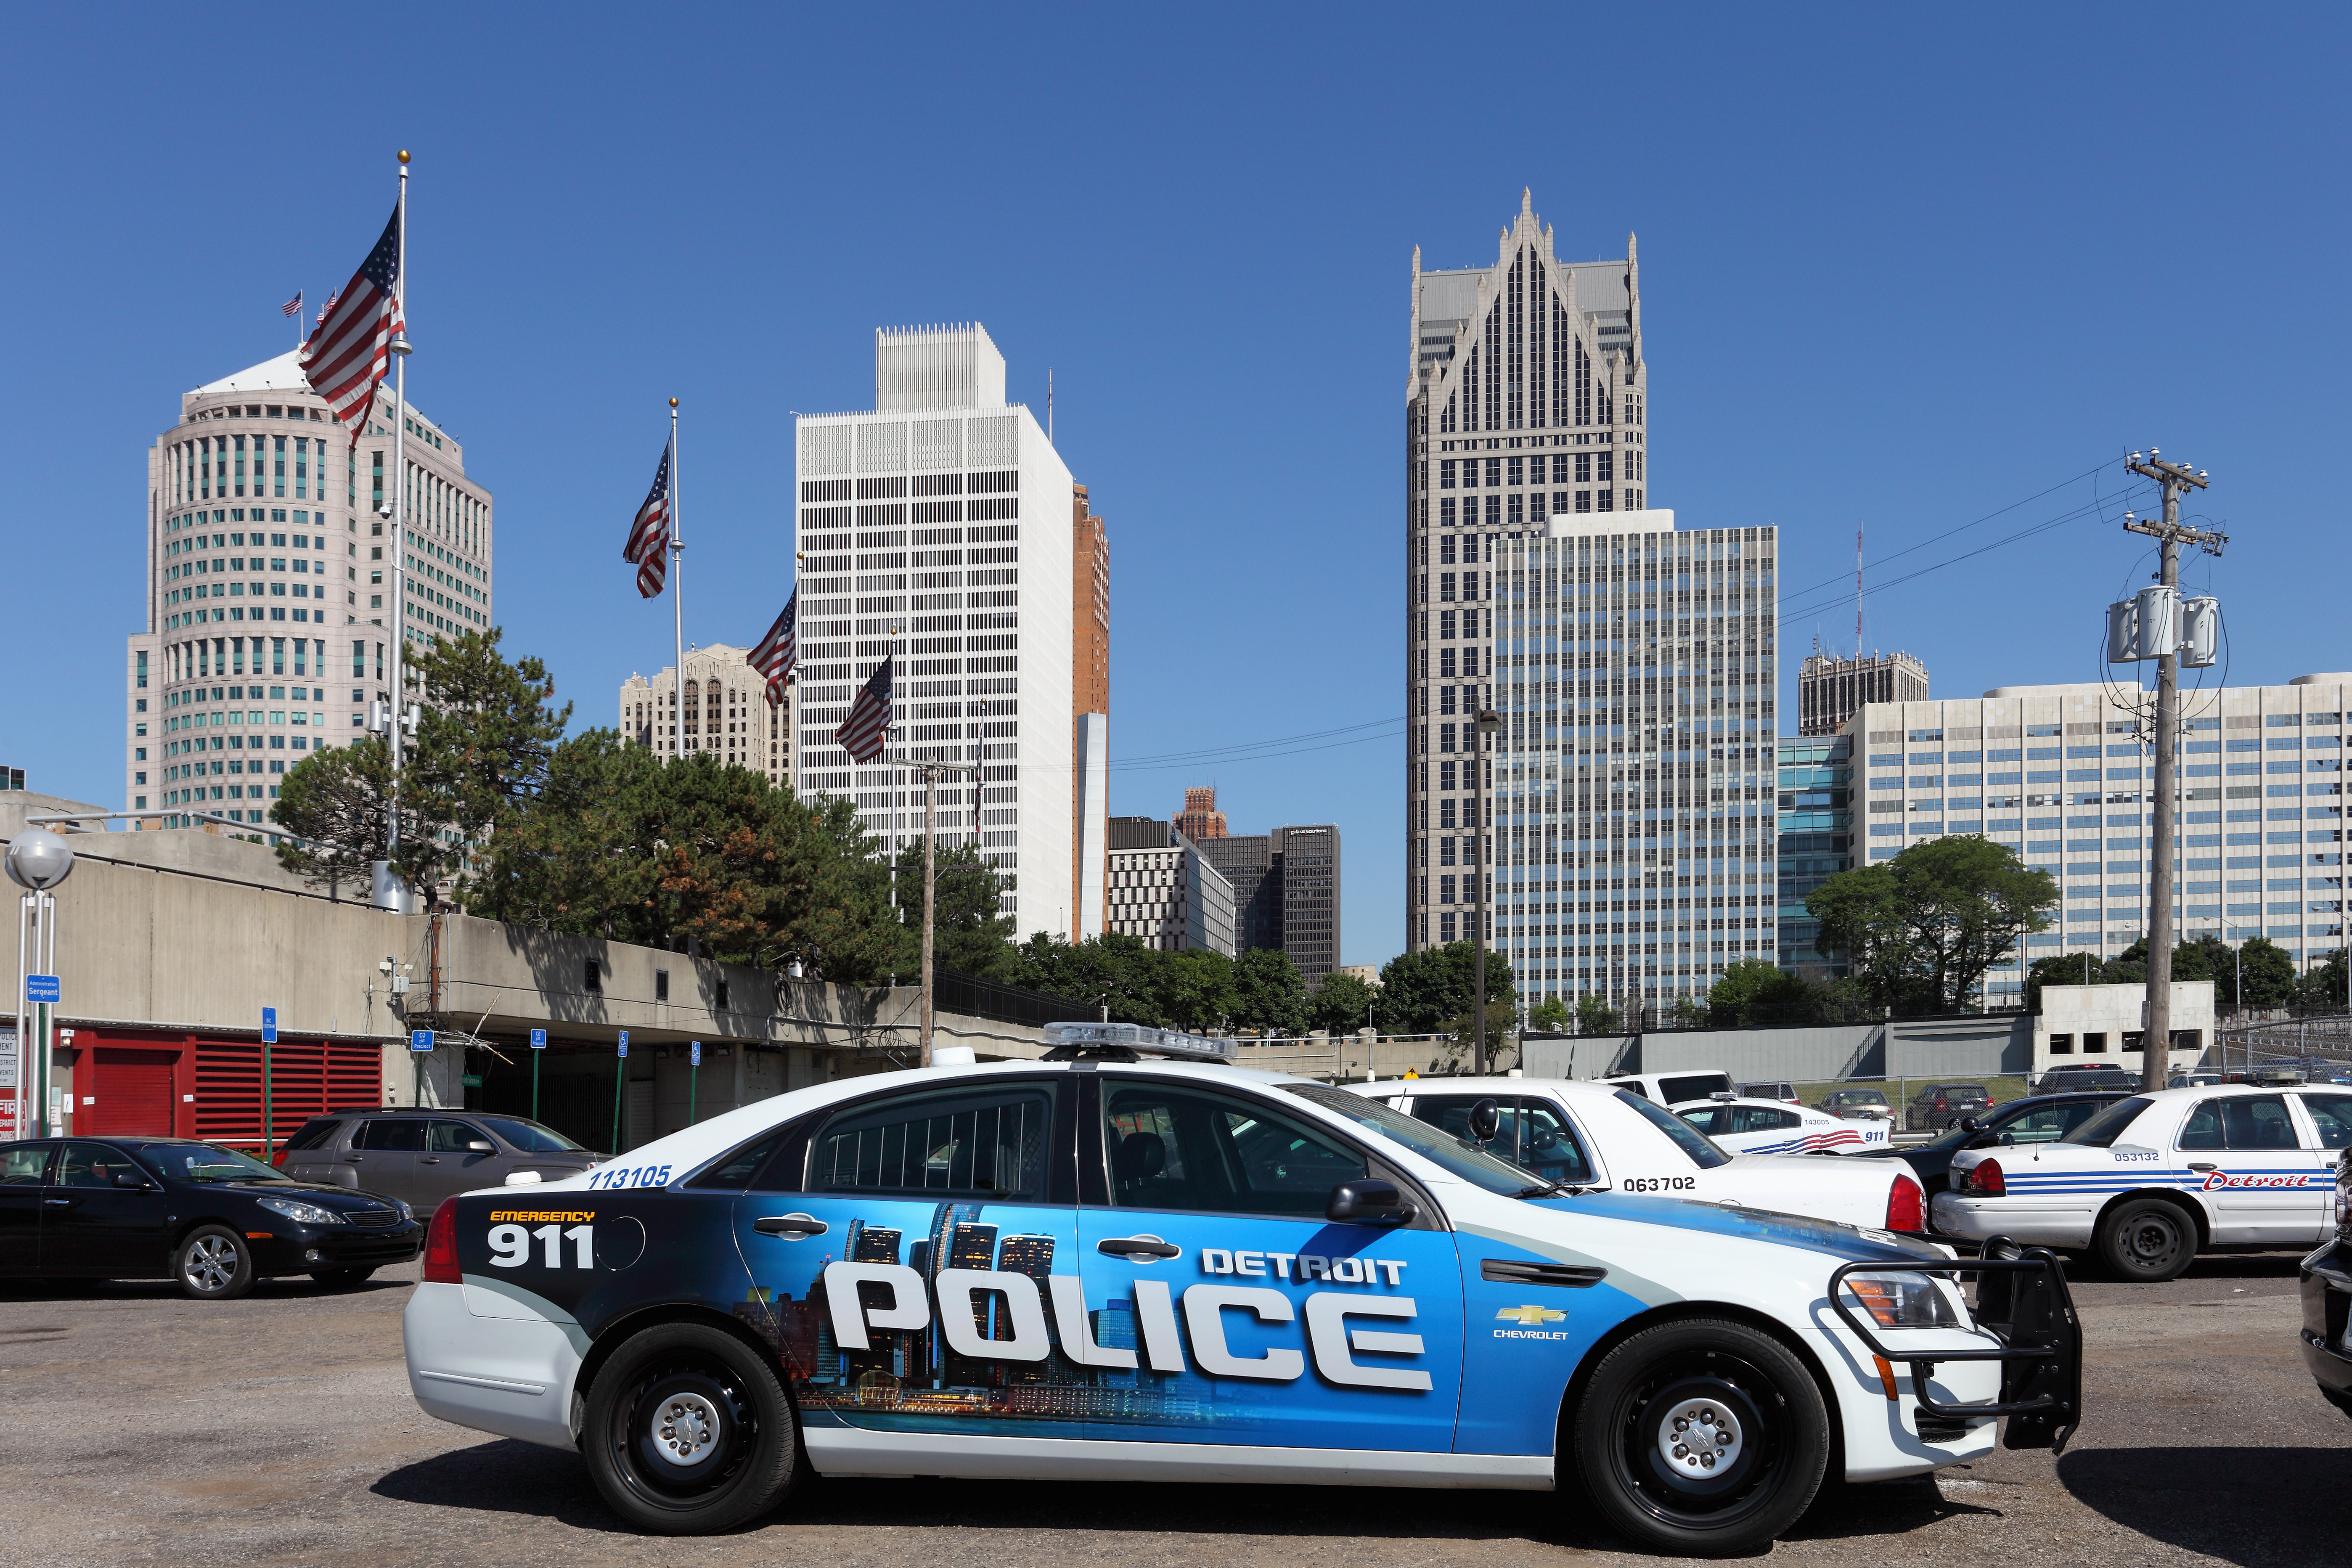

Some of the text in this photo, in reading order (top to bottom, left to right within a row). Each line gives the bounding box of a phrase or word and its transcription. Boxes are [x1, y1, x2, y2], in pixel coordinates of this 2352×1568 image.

[29, 987, 58, 997] Sergeant
[1865, 1131, 1884, 1142] 911
[2115, 1152, 2159, 1162] 053132
[589, 1165, 672, 1189] 113105
[1624, 1177, 1695, 1192] 063702
[2203, 1171, 2310, 1191] Detroit
[490, 1210, 595, 1222] EMERGENCY
[487, 1224, 593, 1269] 911
[1202, 1248, 1407, 1285] DETROIT
[824, 1261, 1433, 1391] POLICE
[1494, 1330, 1568, 1340] CHEVROLET
